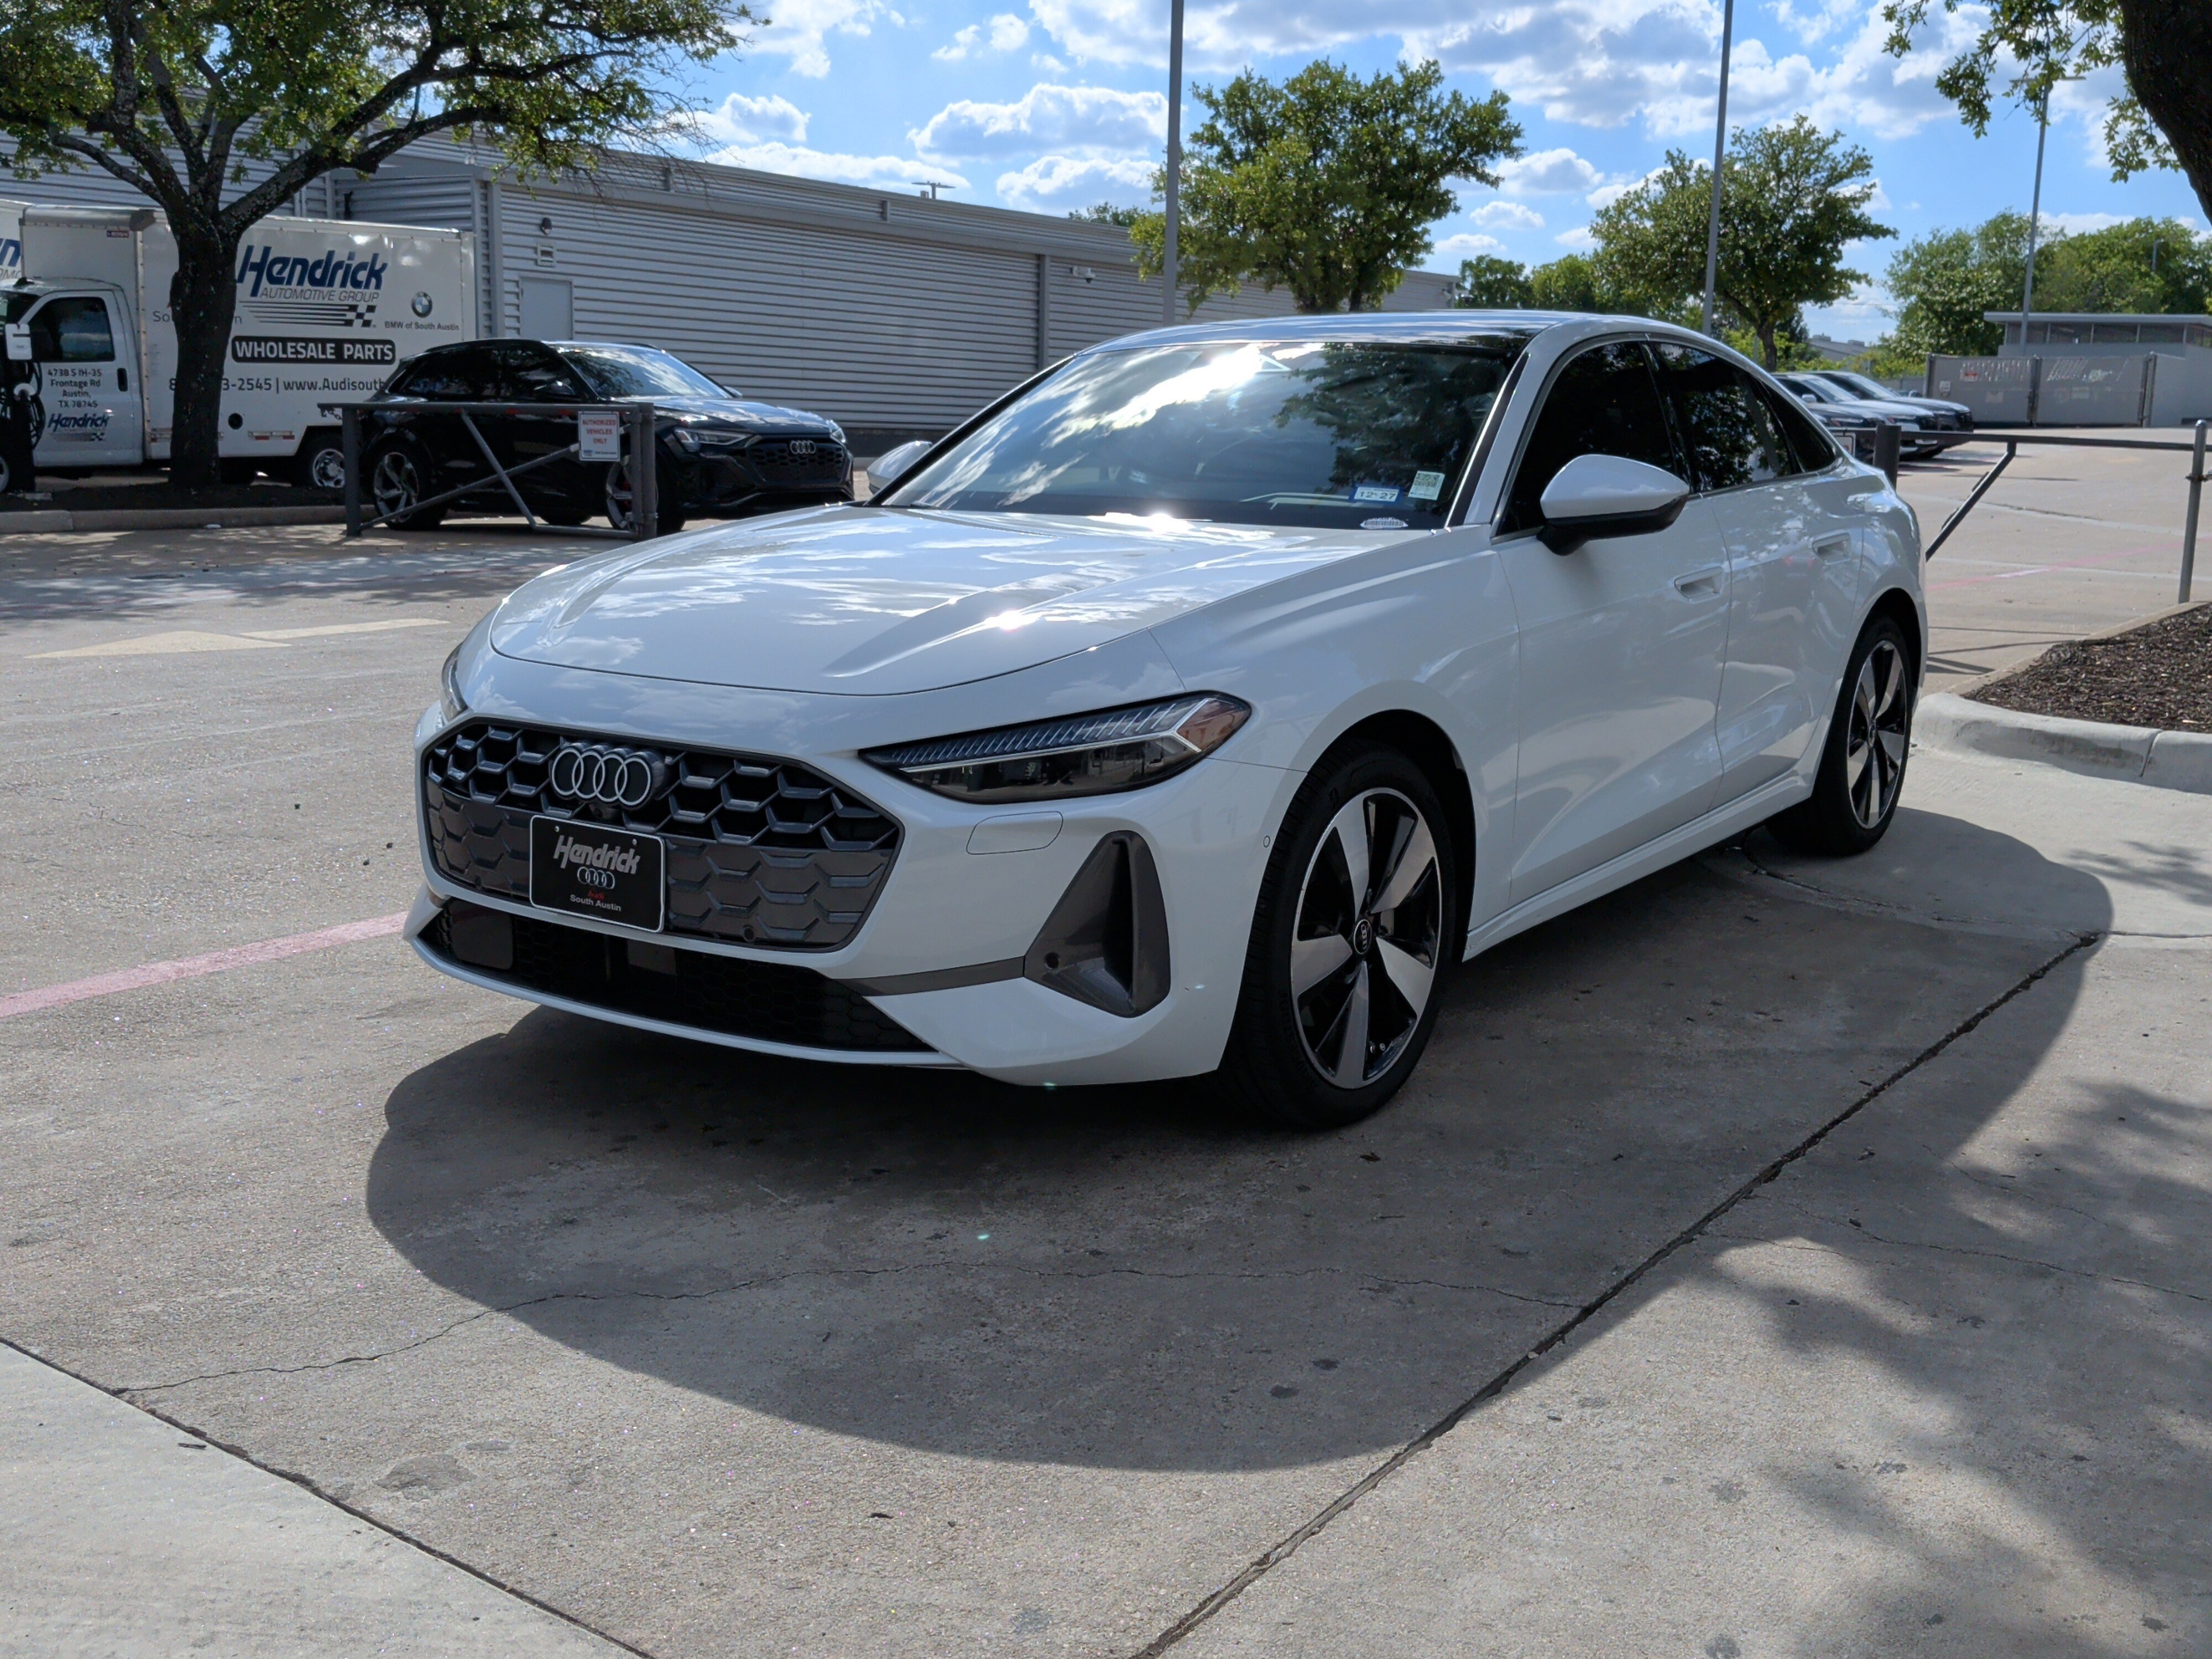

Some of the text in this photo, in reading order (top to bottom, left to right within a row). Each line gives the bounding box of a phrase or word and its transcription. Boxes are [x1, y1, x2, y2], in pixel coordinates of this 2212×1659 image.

[237, 245, 388, 297] Hendrick
[260, 288, 380, 302] AUTOMOTIVE GROUP
[235, 341, 393, 360] WHOLESALE PARTS
[50, 379, 88, 389] Frontage
[48, 413, 111, 432] Hendrick
[553, 834, 640, 874] Hendrick
[570, 894, 622, 911] South Austin
